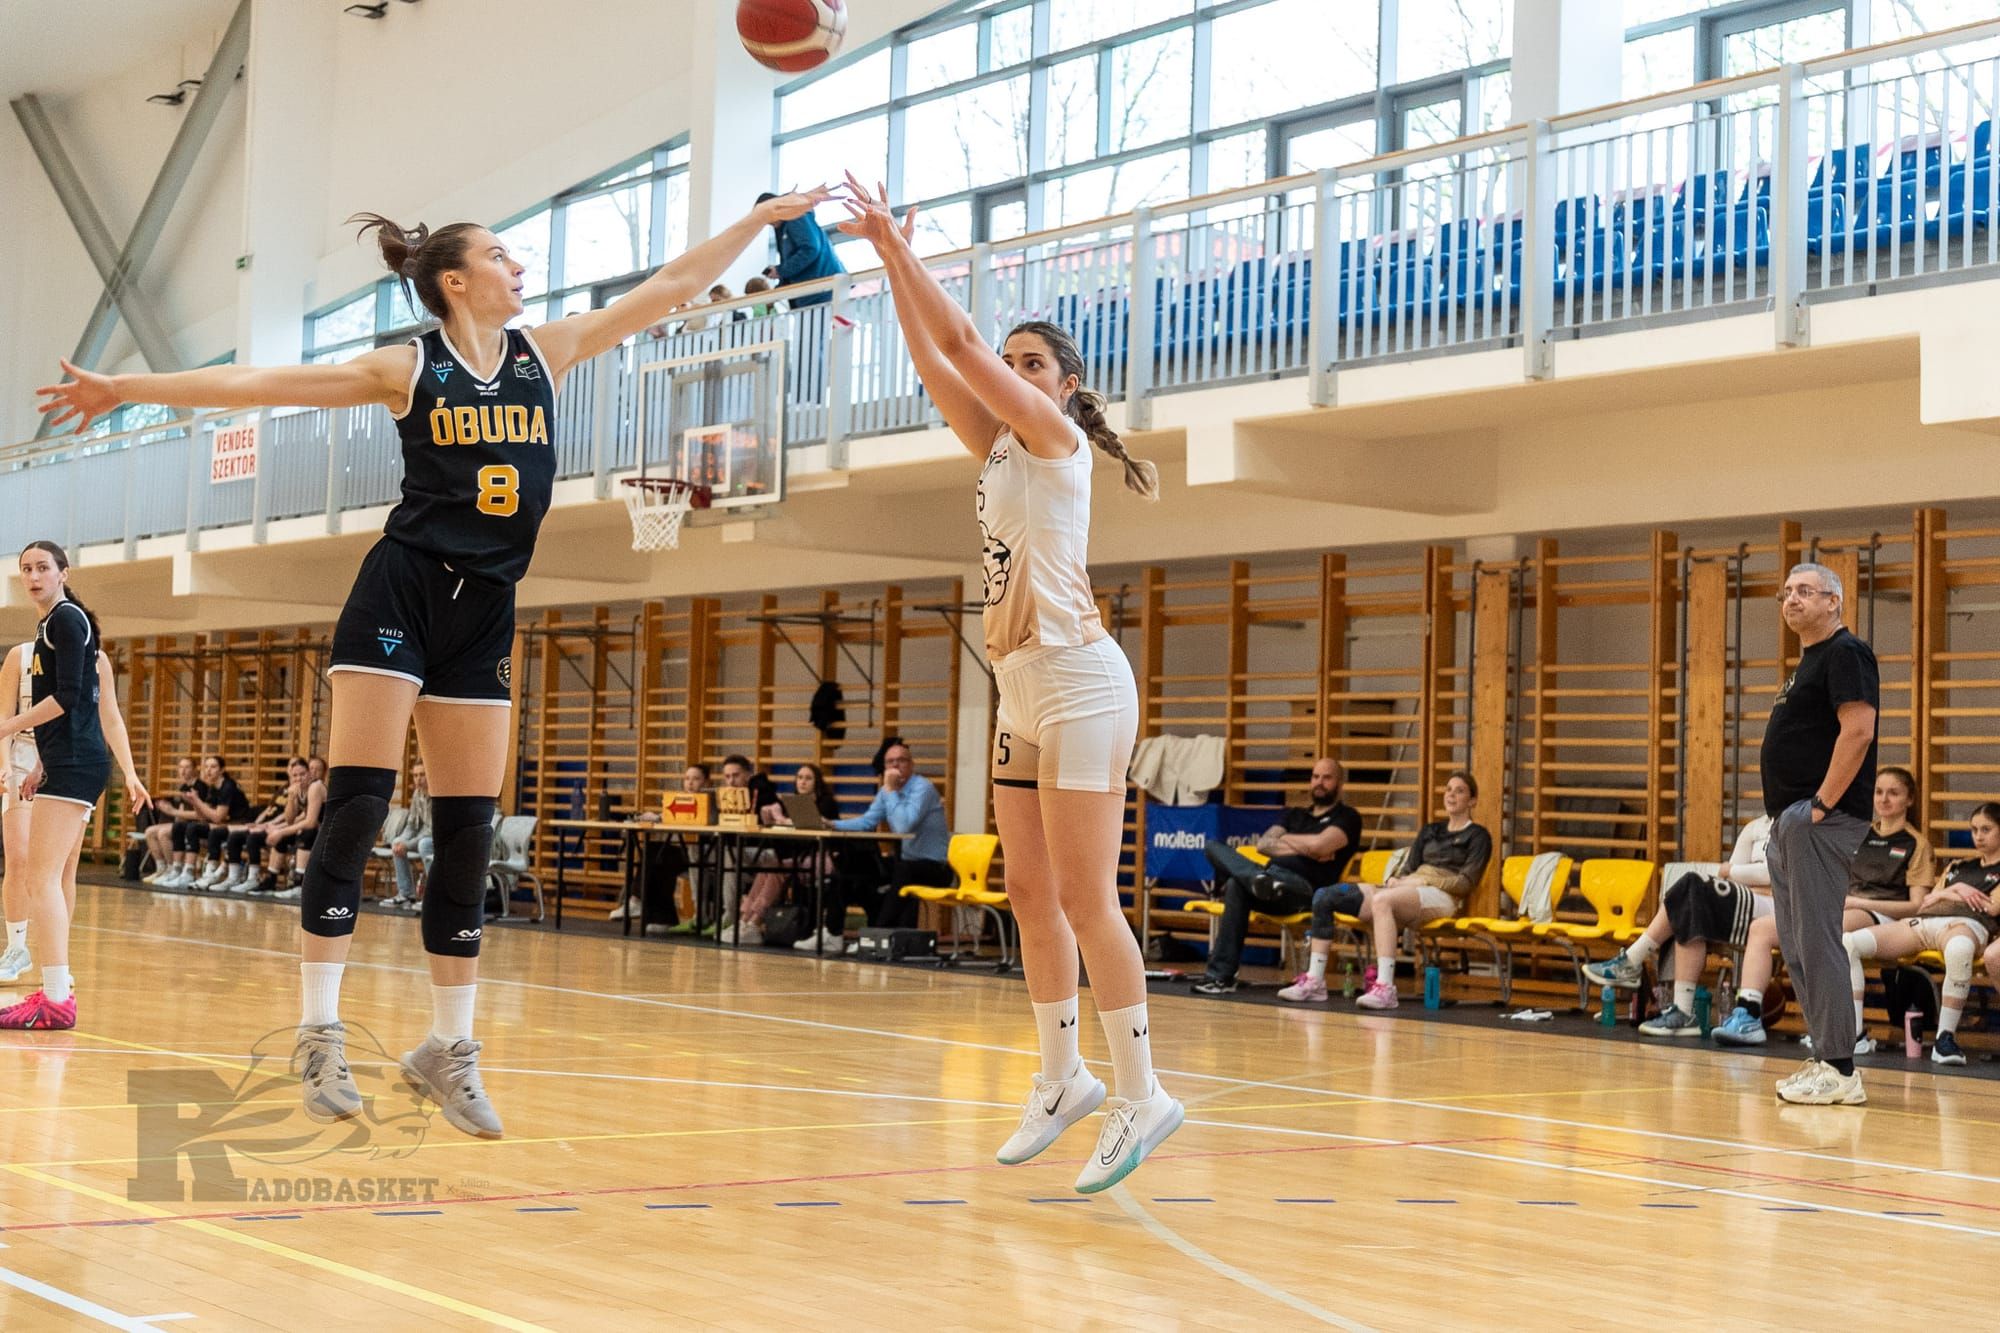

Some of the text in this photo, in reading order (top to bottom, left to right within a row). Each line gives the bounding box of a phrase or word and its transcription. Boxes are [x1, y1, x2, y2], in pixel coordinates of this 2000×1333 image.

[430, 397, 548, 445] ÓBUDA
[213, 454, 255, 480] SZEKTOR
[477, 465, 520, 517] 8
[998, 732, 1011, 765] 5
[1154, 830, 1205, 849] molten
